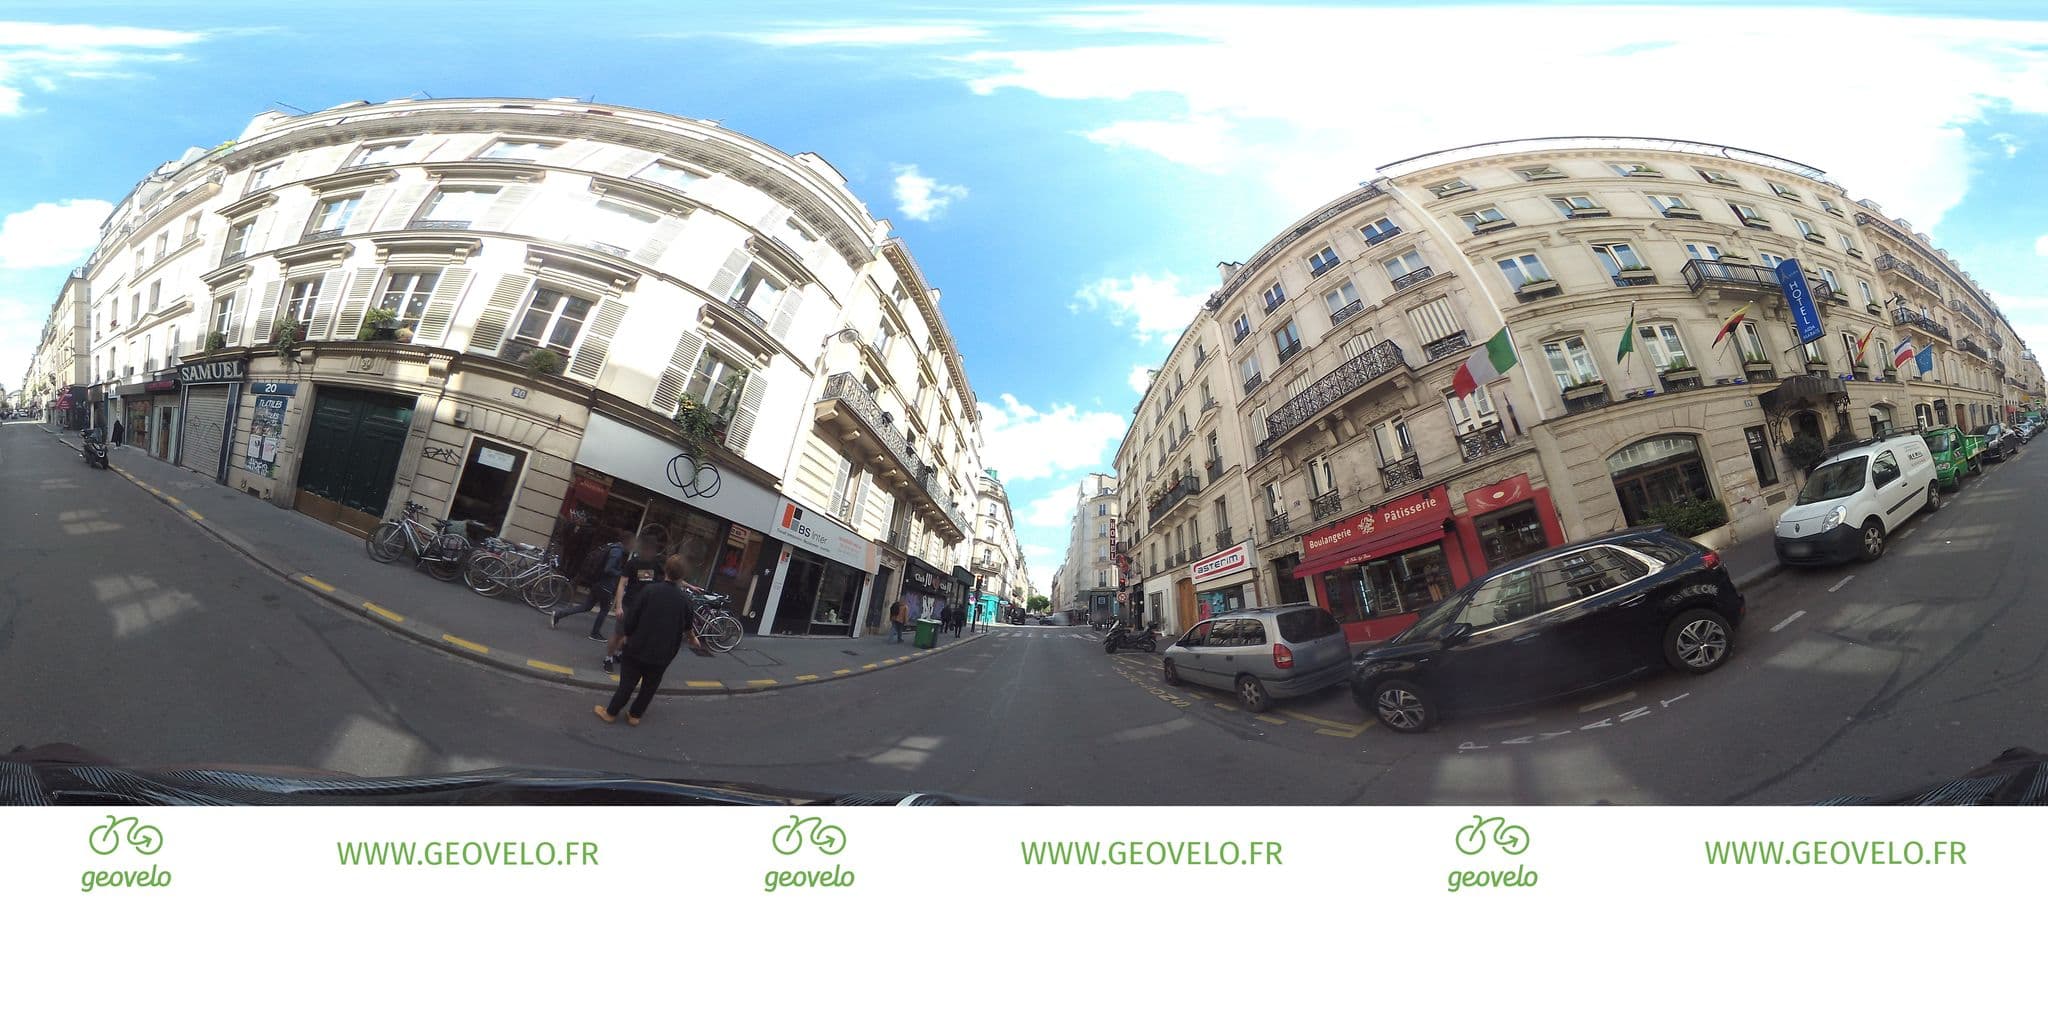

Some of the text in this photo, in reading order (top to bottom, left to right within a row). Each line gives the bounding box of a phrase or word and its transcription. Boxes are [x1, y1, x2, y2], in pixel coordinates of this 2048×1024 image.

[1789, 281, 1811, 325] HOTEL
[181, 360, 244, 381] SAMUEL
[265, 383, 277, 393] 20
[1384, 497, 1437, 523] Pâtisserie
[798, 524, 811, 538] BS
[1309, 528, 1352, 550] Boulangerie
[1458, 692, 1690, 754] PAYANT
